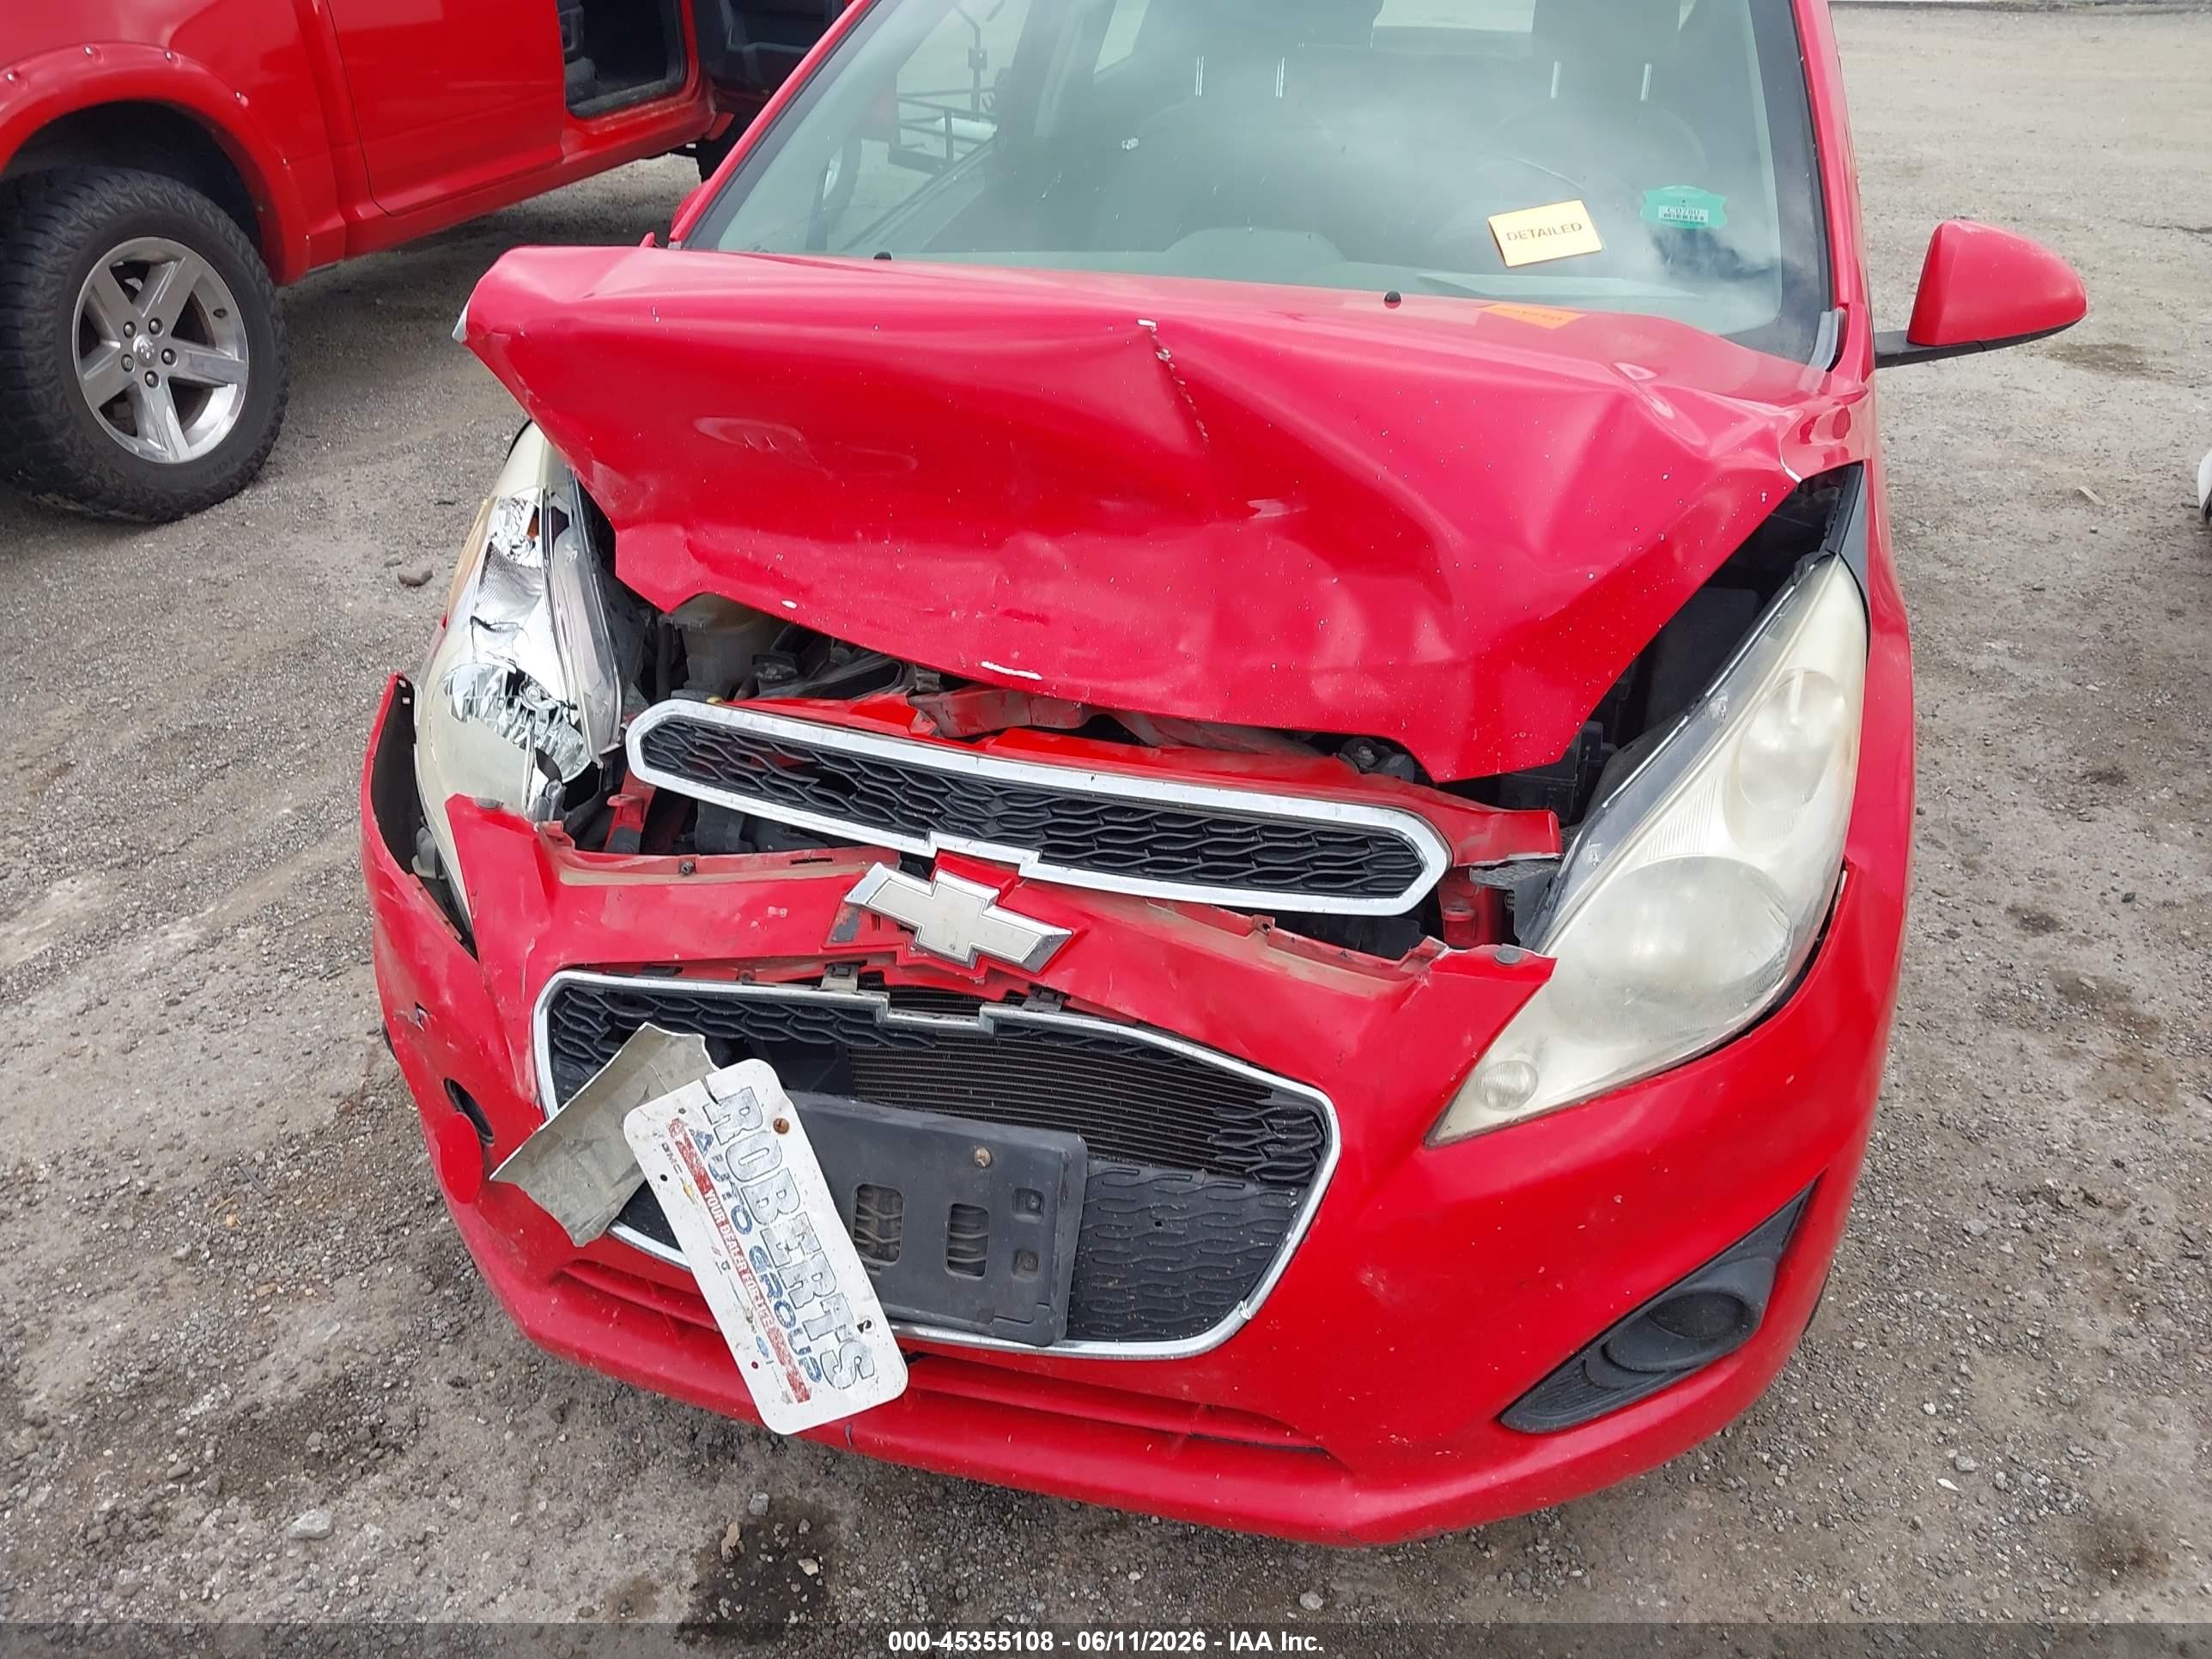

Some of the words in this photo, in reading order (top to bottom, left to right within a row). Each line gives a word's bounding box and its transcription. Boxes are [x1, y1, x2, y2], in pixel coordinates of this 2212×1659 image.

[1507, 222, 1582, 240] DETAILED
[690, 1129, 752, 1235] AUTO
[750, 1245, 822, 1383] GROUP
[702, 1086, 876, 1390] ROBERTS
[704, 1190, 726, 1224] YOUR
[720, 1224, 748, 1271] DEALER
